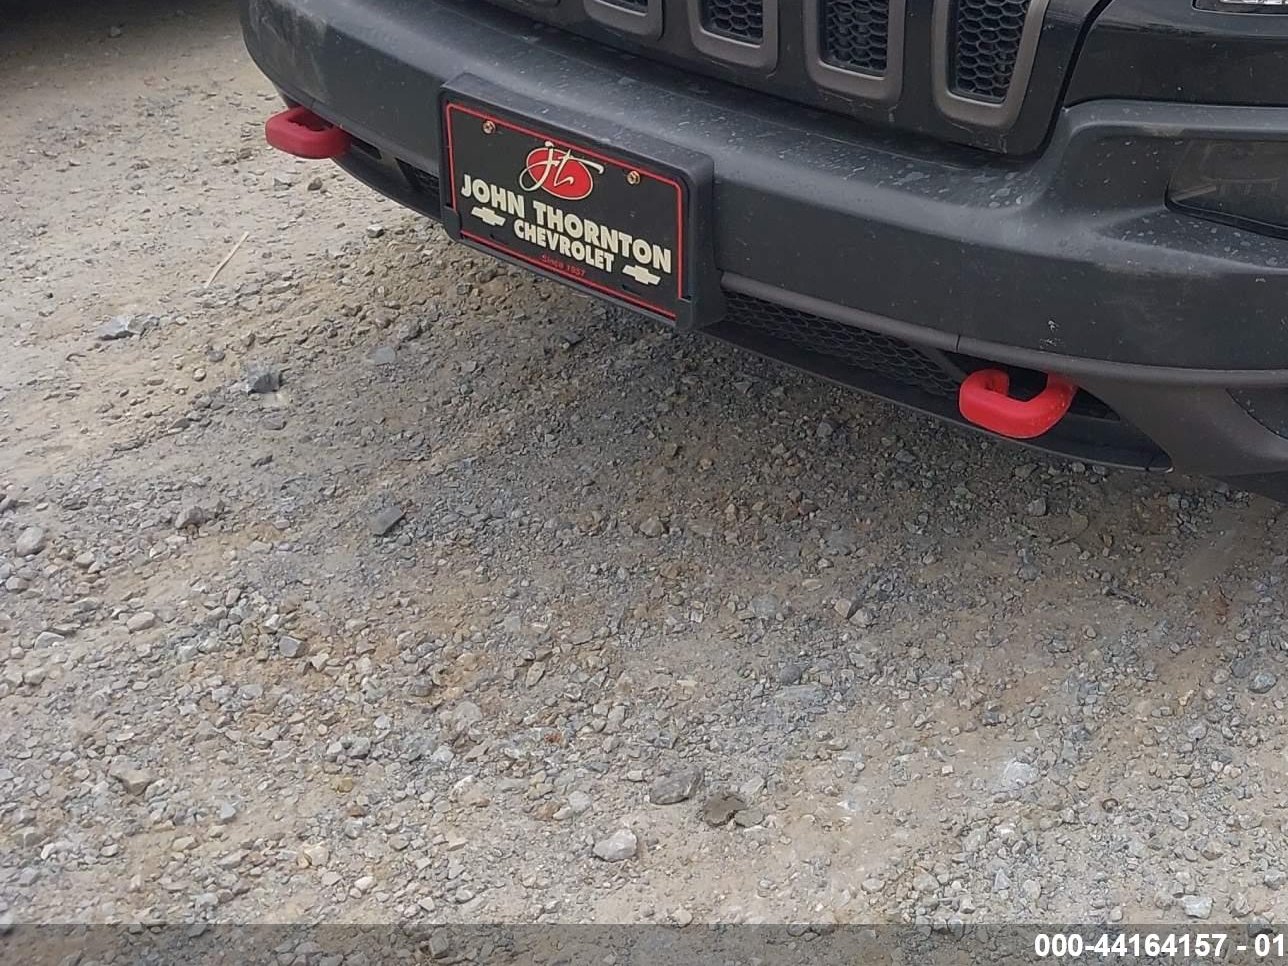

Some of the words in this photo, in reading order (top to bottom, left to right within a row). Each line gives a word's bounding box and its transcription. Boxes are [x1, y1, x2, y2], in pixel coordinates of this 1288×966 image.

[461, 174, 525, 218] JOHN
[533, 200, 672, 274] THORNTON
[513, 219, 614, 273] CHEVROLET
